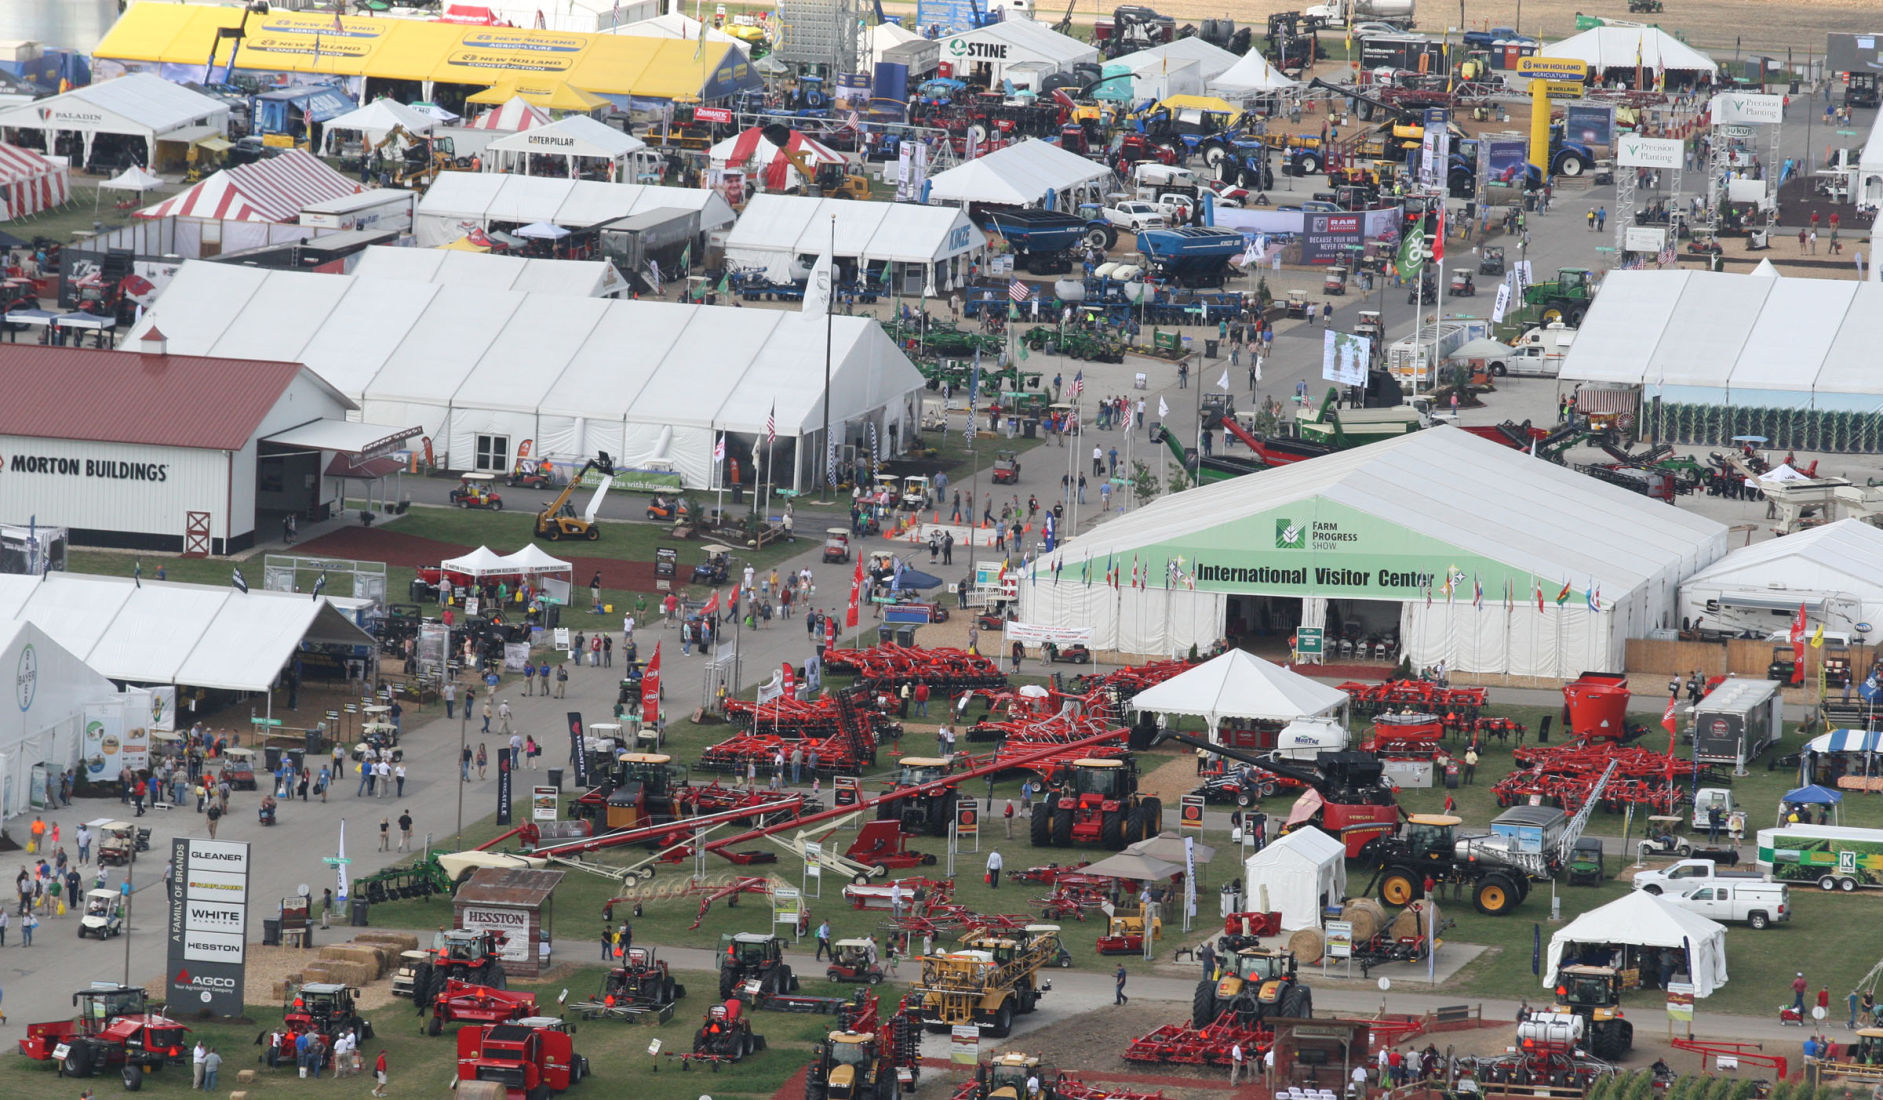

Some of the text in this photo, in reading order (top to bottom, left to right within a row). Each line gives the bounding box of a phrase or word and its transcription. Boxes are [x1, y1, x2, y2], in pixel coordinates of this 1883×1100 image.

[489, 42, 552, 51] AGRICULTURE
[967, 42, 1007, 59] STINE
[467, 62, 545, 71] CONSTRUCTION
[1532, 71, 1569, 79] AGRICULTURE
[1746, 98, 1779, 107] Precision
[55, 112, 103, 121] PALADIN
[1746, 108, 1776, 118] Planting
[528, 135, 574, 147] CATERPILLAR
[1640, 143, 1675, 151] Precision
[1640, 152, 1673, 164] Planting
[949, 223, 972, 251] KINZE
[11, 455, 167, 482] MORTON BUILDINGS
[1312, 521, 1338, 531] FARM
[1312, 531, 1358, 542] PROGRESS
[1312, 542, 1337, 550] SHOW
[1198, 563, 1435, 588] International Visitor Center
[576, 735, 585, 777] VERSATILE
[191, 851, 242, 862] GLEANER
[175, 844, 184, 883] BRANDS
[174, 884, 183, 898] OF
[173, 900, 182, 933] FAMILY
[192, 909, 240, 921] WHITE
[469, 911, 525, 925] HESSTON
[188, 942, 240, 952] HESSTON
[192, 976, 236, 987] AGCO
[185, 984, 211, 992] Agriculture
[212, 986, 234, 994] Company
